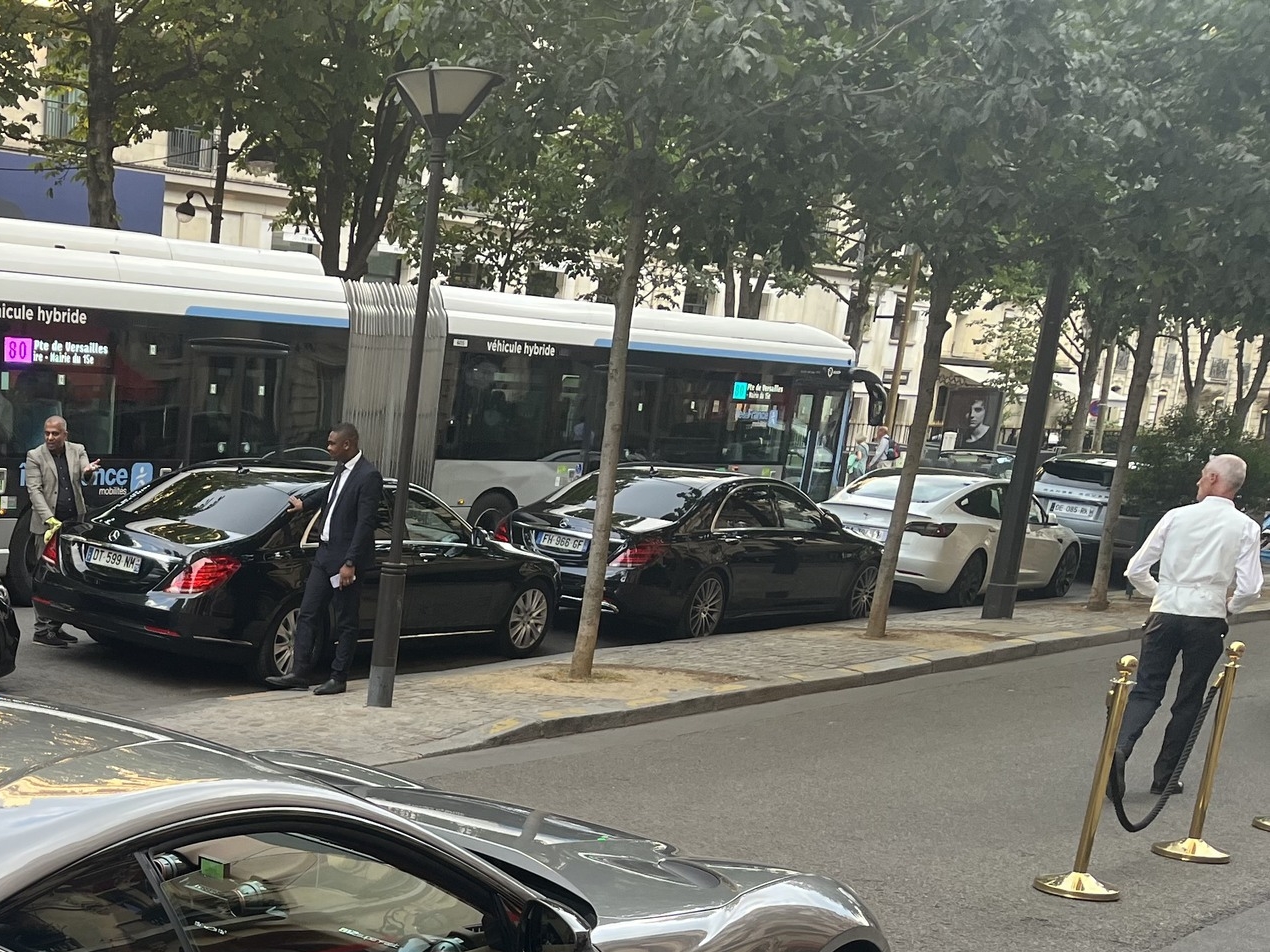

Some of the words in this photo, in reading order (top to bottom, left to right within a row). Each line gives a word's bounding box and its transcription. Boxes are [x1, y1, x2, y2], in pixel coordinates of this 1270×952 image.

[37, 306, 88, 325] hybride
[8, 340, 27, 360] 80
[33, 339, 50, 352] Pte
[51, 339, 63, 352] de
[64, 341, 109, 355] Versailles
[486, 339, 522, 355] véhicule
[523, 342, 556, 357] hybride
[49, 351, 71, 363] Mairie
[72, 352, 82, 364] du
[82, 354, 95, 365] 15e
